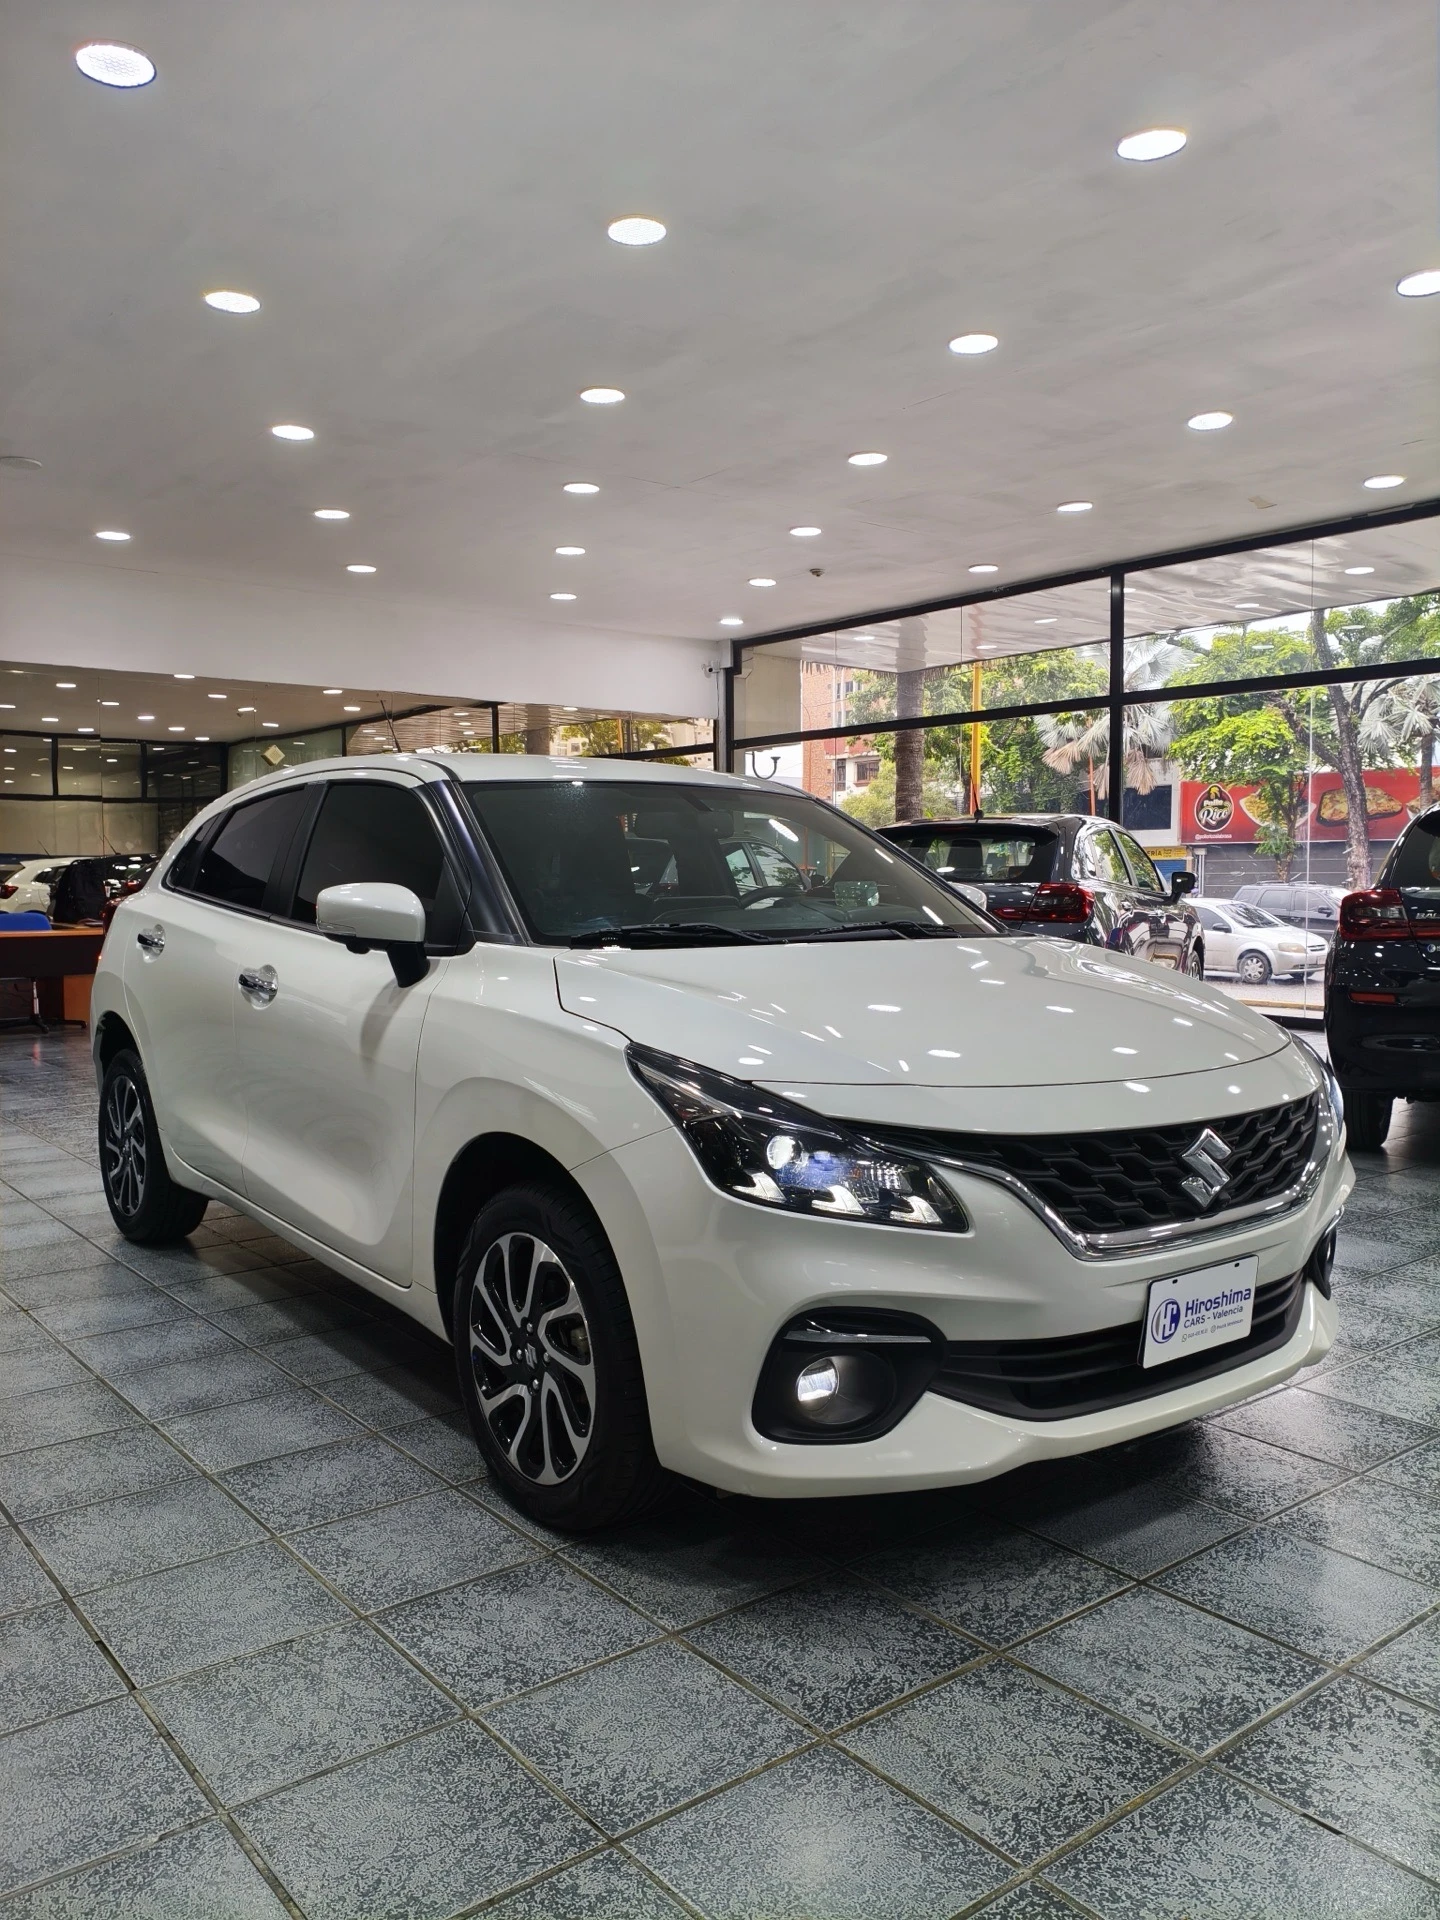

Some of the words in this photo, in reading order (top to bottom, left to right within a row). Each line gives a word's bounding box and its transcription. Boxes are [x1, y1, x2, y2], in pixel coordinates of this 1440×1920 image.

[1200, 807, 1228, 825] Rico
[1184, 1288, 1252, 1317] Hiroshima
[1183, 1314, 1206, 1329] CARS
[1212, 1305, 1243, 1320] Valencia
